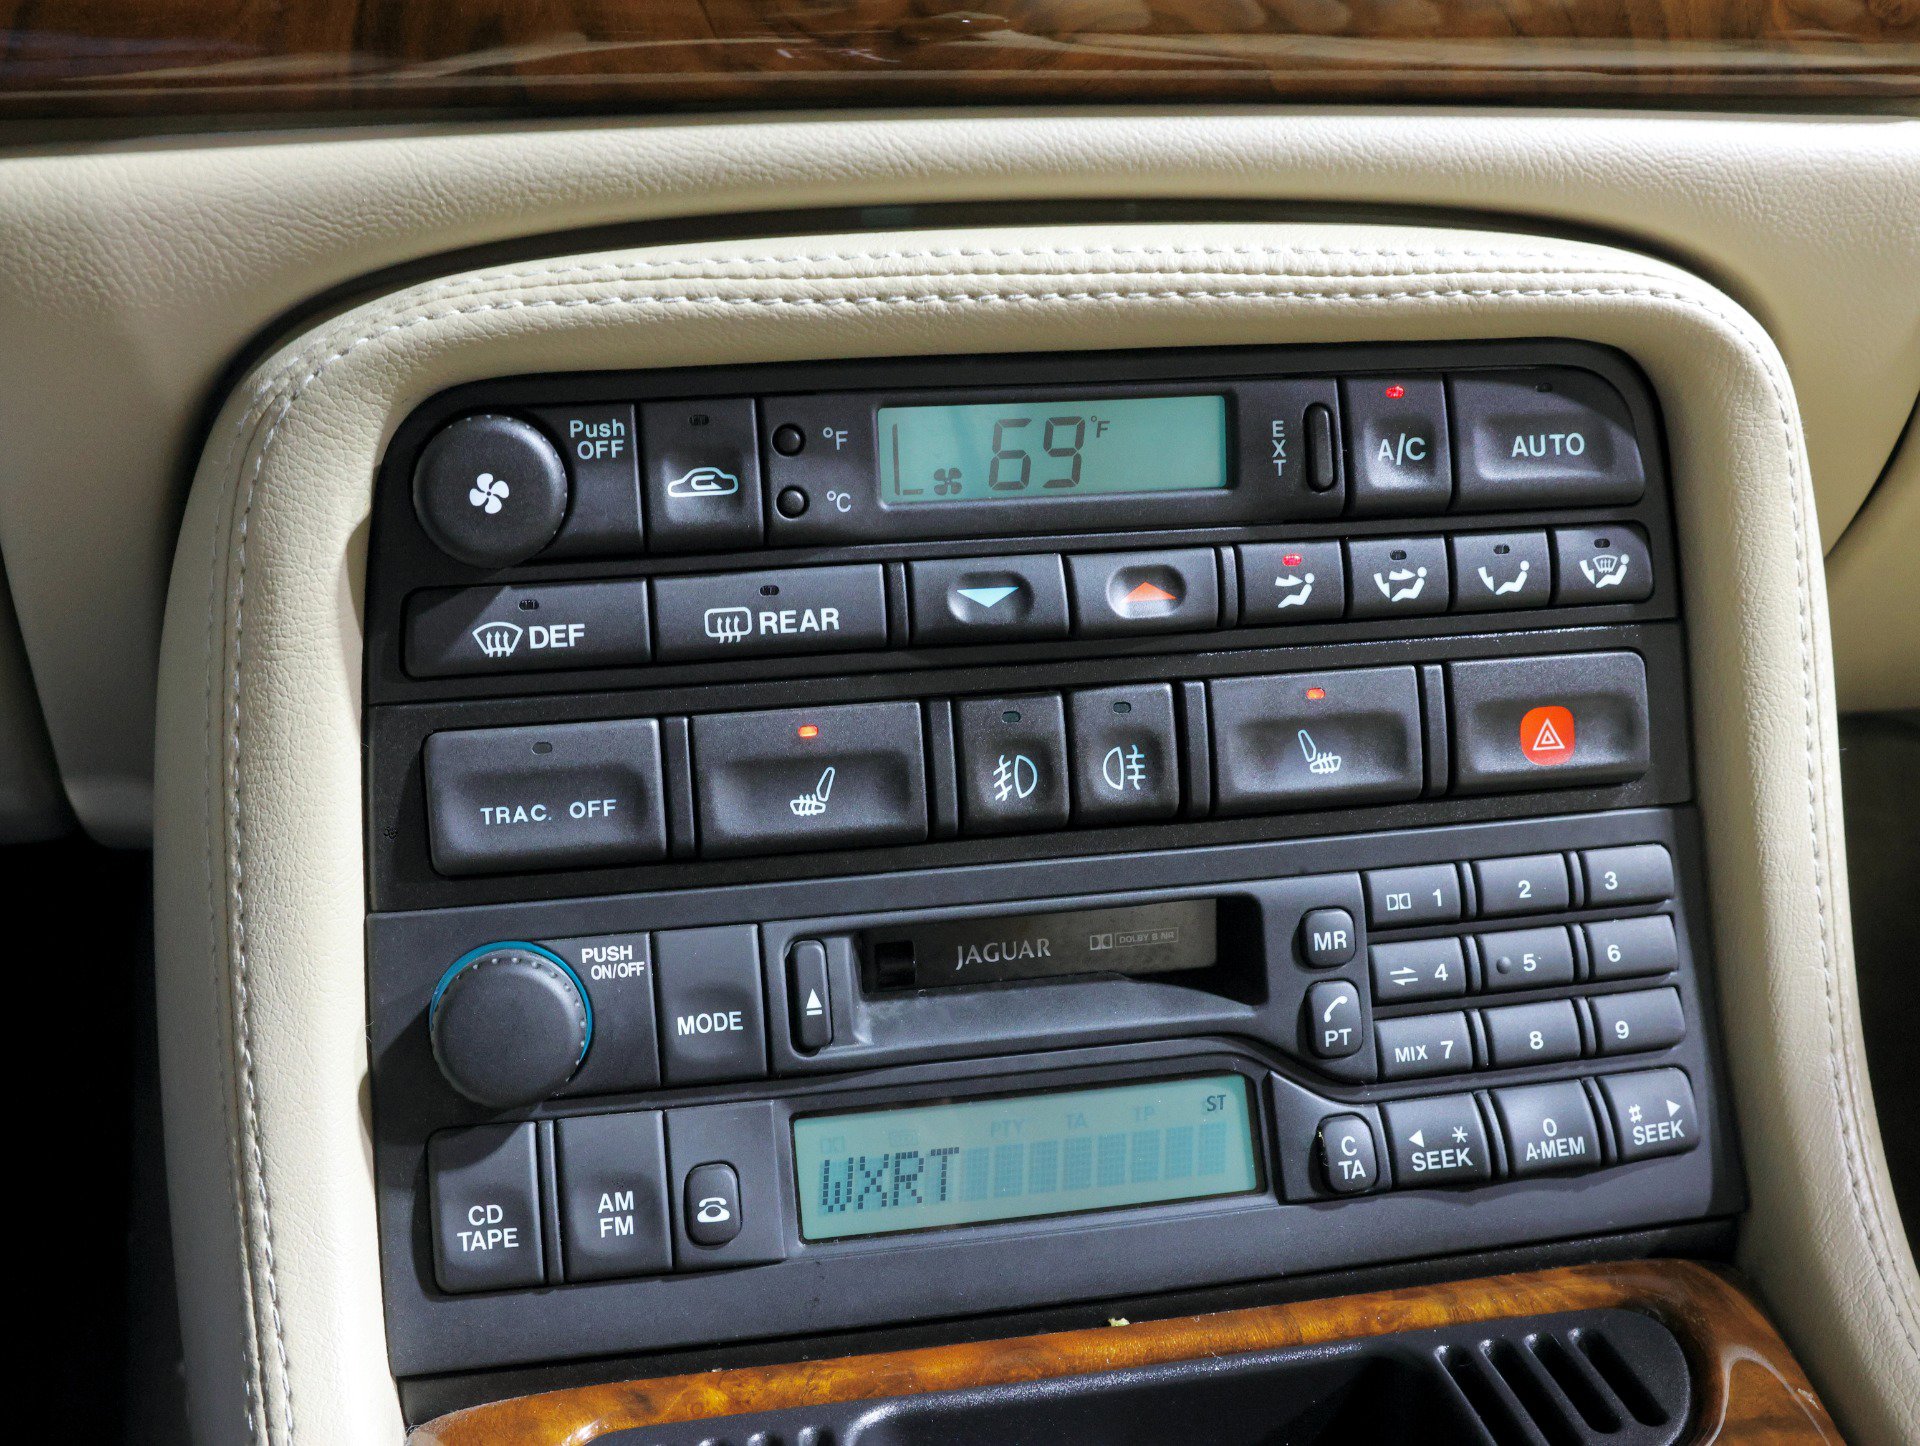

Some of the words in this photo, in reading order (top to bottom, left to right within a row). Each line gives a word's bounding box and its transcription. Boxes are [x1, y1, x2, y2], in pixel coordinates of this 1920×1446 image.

[569, 420, 625, 438] Push
[577, 440, 624, 459] OFF
[1377, 433, 1426, 465] A/C
[1511, 432, 1585, 457] AUTO
[759, 608, 840, 635] REAR
[528, 624, 586, 650] DEF
[480, 804, 552, 825] TRAC.
[569, 799, 617, 819] OFF
[1518, 880, 1532, 898] 2
[1604, 872, 1618, 890] 3
[1432, 889, 1443, 907] 1
[1119, 934, 1150, 943] DOLBY
[1313, 930, 1347, 951] MR
[581, 945, 634, 963] PUSH
[956, 938, 1051, 970] JAGUAR
[1523, 954, 1537, 972] 5
[1607, 945, 1621, 962] 6
[590, 962, 645, 980] ON/OFF
[1434, 964, 1449, 981] 4
[677, 1011, 744, 1035] MODE
[1615, 1021, 1630, 1039] 9
[1325, 1028, 1352, 1047] PT
[1529, 1031, 1544, 1050] 8
[1395, 1046, 1428, 1063] MIX
[1441, 1041, 1454, 1059] 7
[1205, 1095, 1227, 1112] ST
[1632, 1119, 1685, 1146] SEEK
[1340, 1136, 1356, 1157] C
[1338, 1160, 1366, 1180] TA
[1412, 1148, 1474, 1172] SEEK
[822, 1146, 960, 1212] WXRT
[597, 1191, 634, 1213] AM
[468, 1204, 503, 1225] CD
[599, 1215, 634, 1238] FM
[457, 1227, 519, 1252] TAPE
